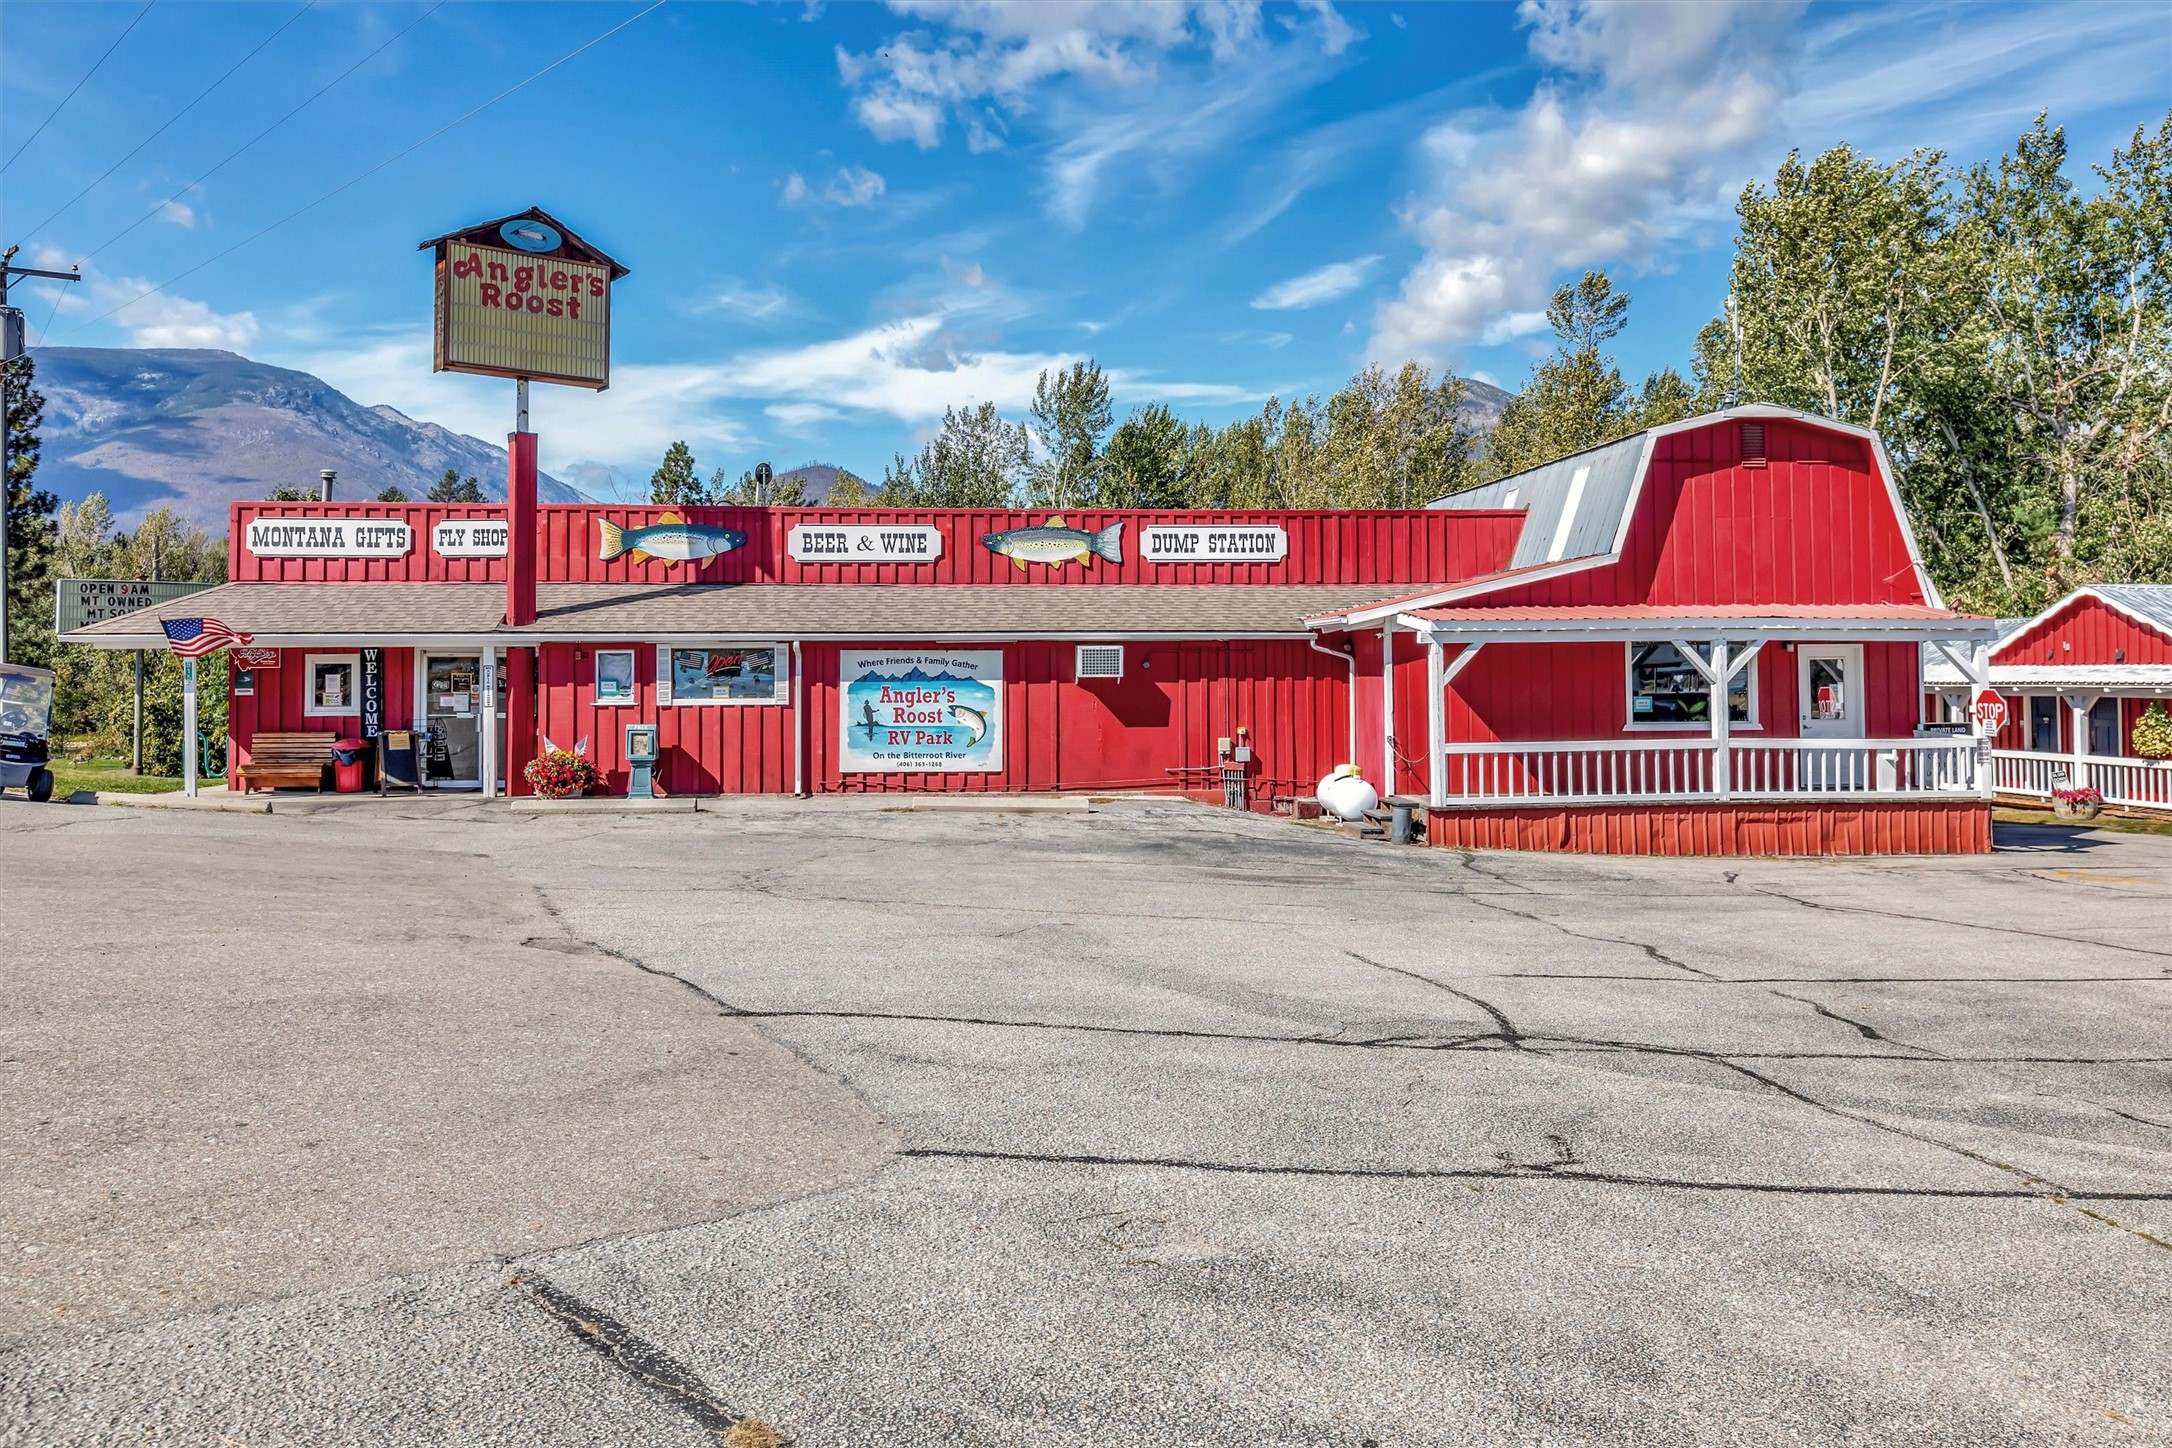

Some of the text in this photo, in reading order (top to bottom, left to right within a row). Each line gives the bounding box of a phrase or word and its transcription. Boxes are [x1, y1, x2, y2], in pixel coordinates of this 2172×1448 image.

[454, 253, 604, 297] Angler's
[480, 283, 581, 319] Roost
[252, 526, 406, 548] MONTANA GIFTS
[438, 529, 508, 546] FLY SHOP
[802, 533, 927, 553] BEER & WINE
[1152, 533, 1276, 553] DUMP STATION
[80, 583, 114, 594] OPEN
[81, 596, 152, 607] MT OWNED
[87, 608, 105, 619] MT
[706, 654, 744, 674] Open
[857, 656, 979, 671] Where Friends & Family Gather
[364, 649, 379, 737] WELCOME
[879, 686, 956, 707] Angler's
[893, 707, 943, 723] Roost
[1977, 702, 2004, 720] STOP
[888, 731, 953, 745] RV Park
[1951, 726, 1967, 734] LAND
